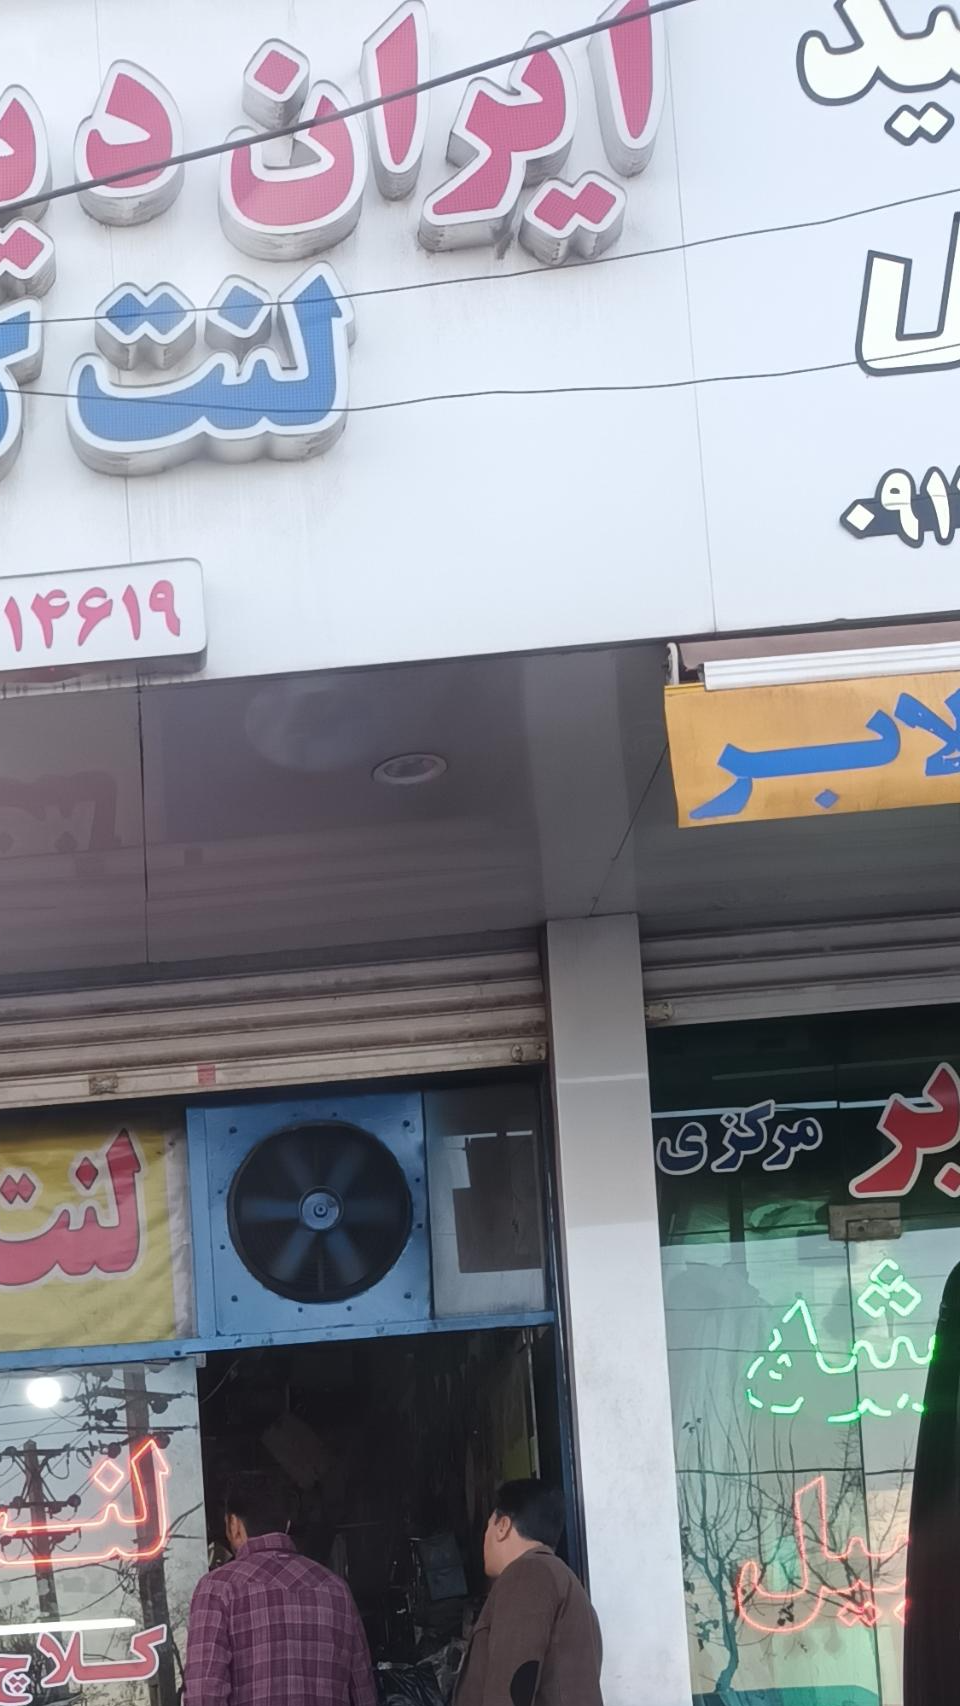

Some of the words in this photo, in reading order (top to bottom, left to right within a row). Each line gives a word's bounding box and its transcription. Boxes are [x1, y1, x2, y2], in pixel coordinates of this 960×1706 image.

[221, 0, 660, 240] ایران
[67, 263, 350, 452] لنت
[841, 464, 960, 549] ۰۹۱
[655, 1099, 823, 1175] مرکزی
